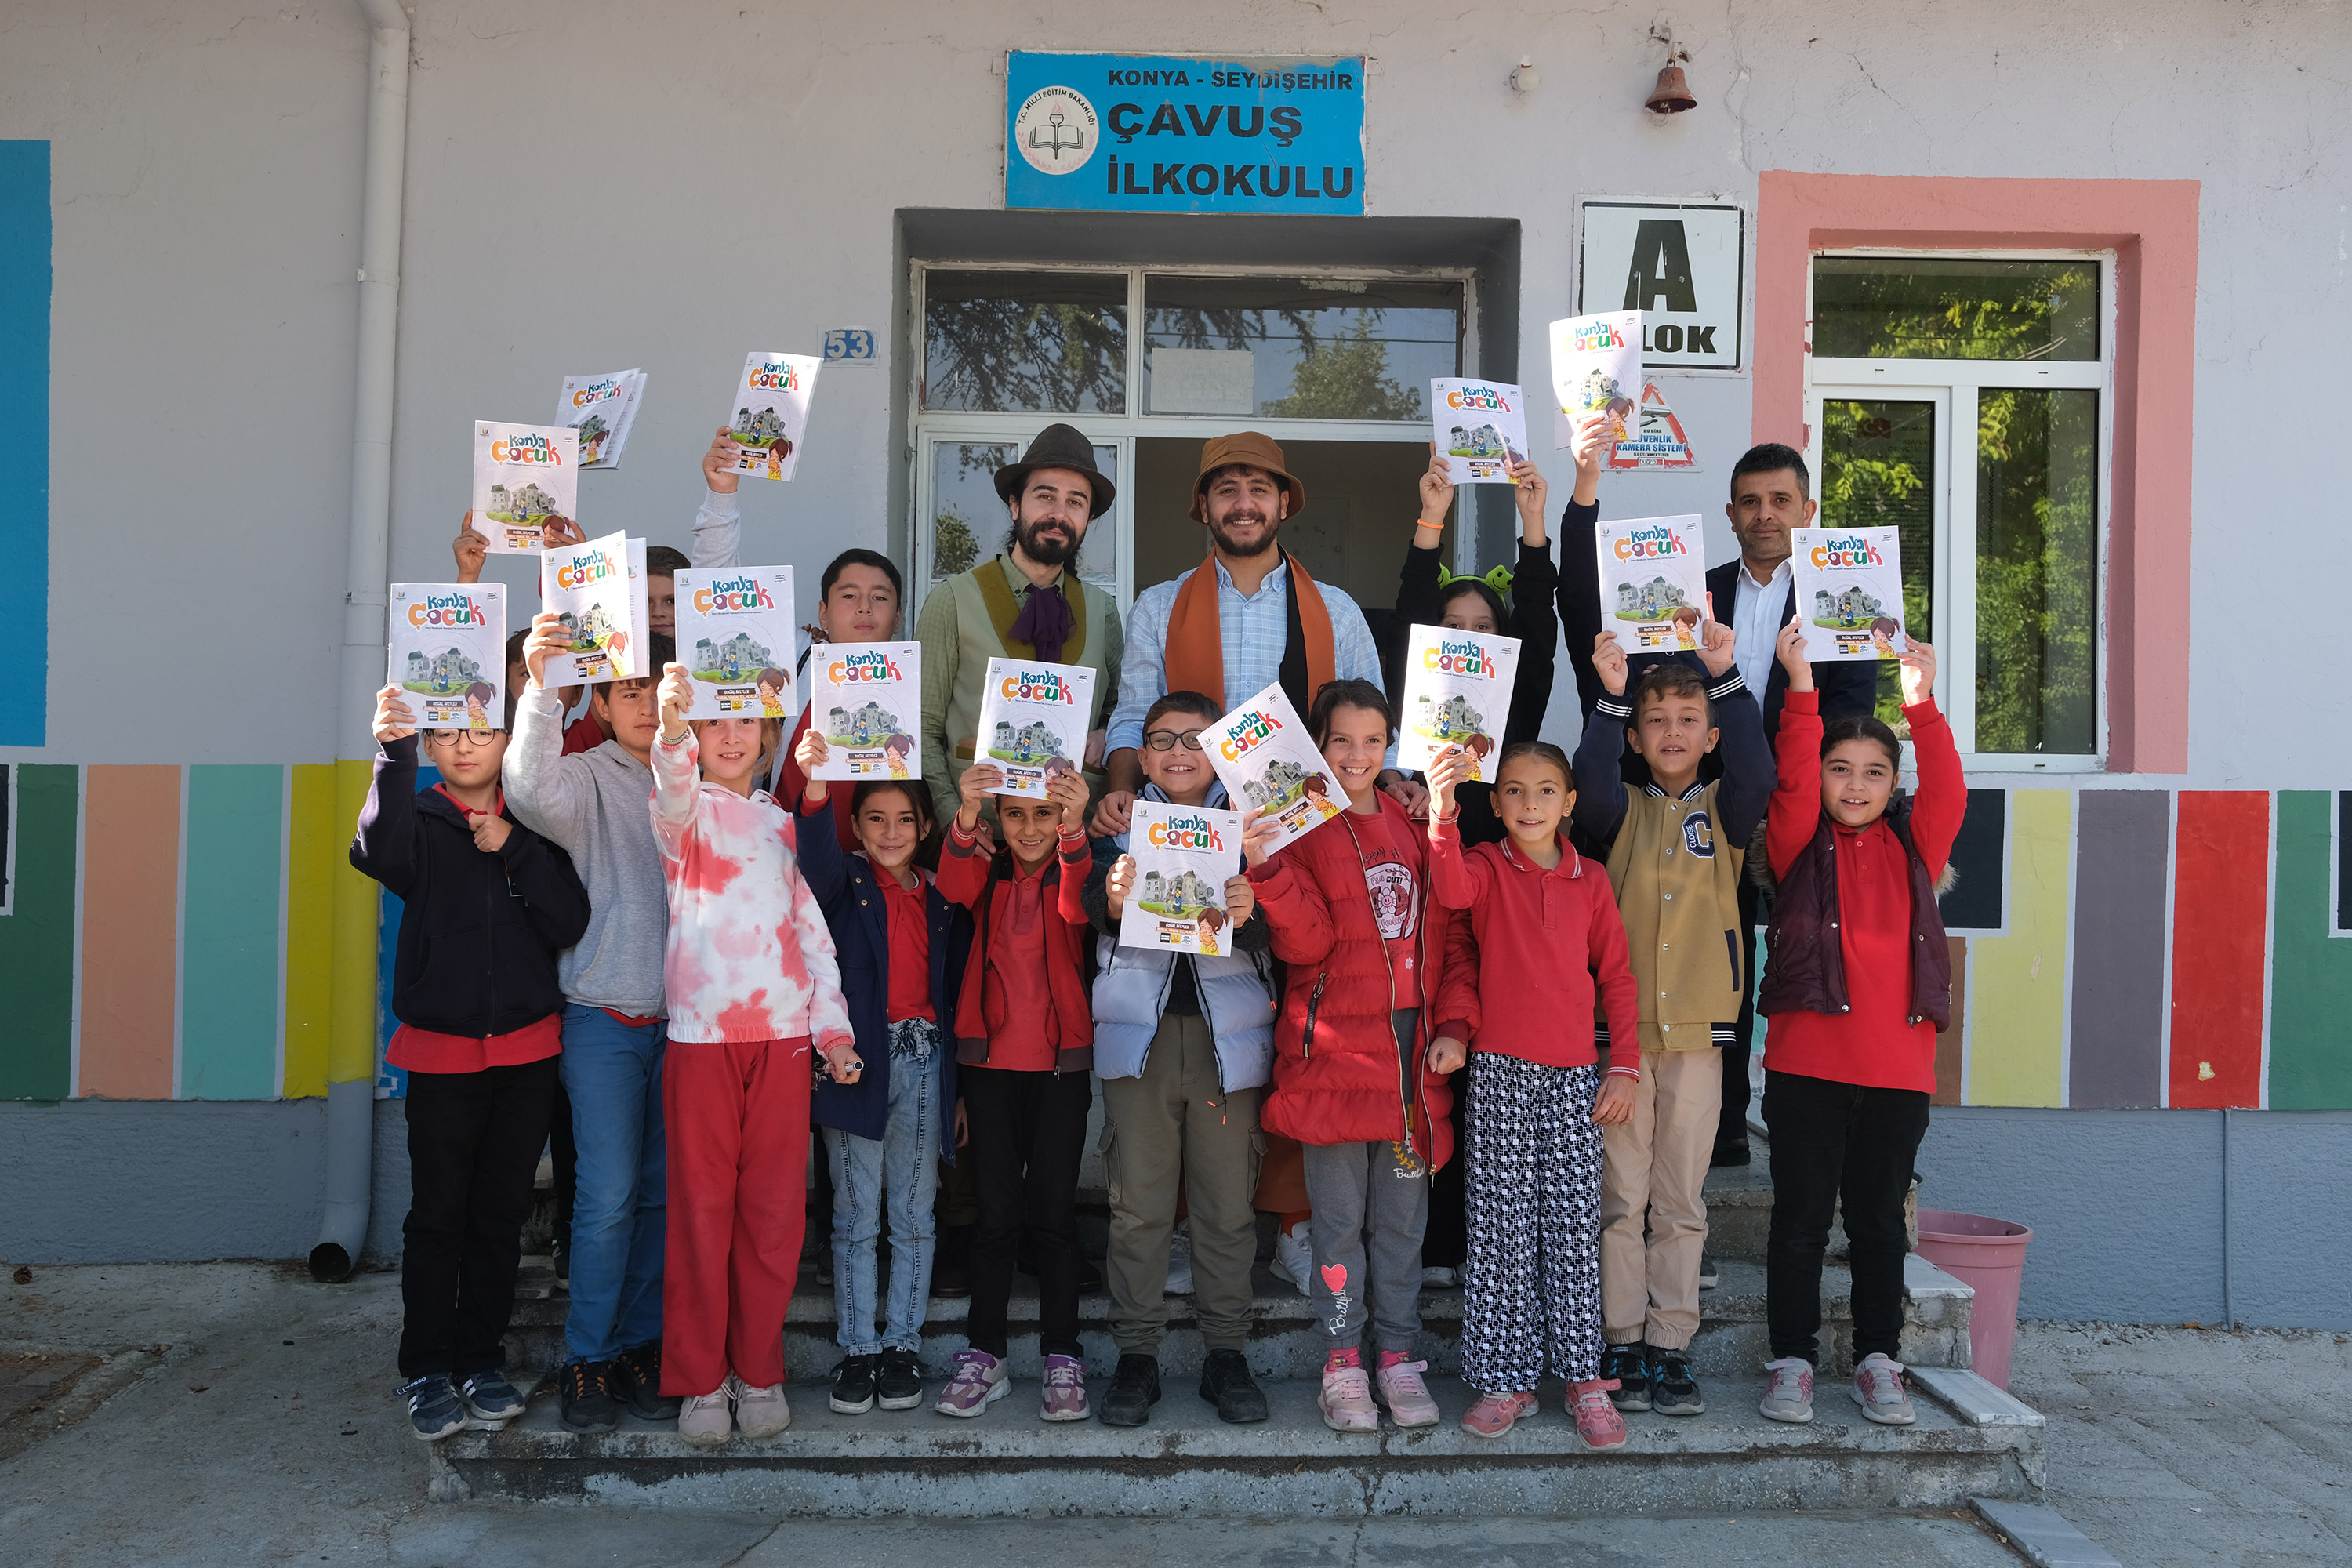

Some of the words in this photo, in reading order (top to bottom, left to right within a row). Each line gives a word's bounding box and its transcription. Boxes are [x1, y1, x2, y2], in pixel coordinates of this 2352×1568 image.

[1109, 70, 1189, 87] KONYA
[1211, 70, 1353, 93] SEYDİŞEHİR
[1025, 93, 1042, 111] MİLLİ
[1043, 88, 1067, 98] EĞİTİM
[1068, 92, 1096, 125] BAKANLIĞI
[1107, 103, 1304, 147] ÇAVUŞ
[1107, 154, 1354, 198] İLKOKULU
[1622, 219, 1697, 313] A
[827, 332, 869, 358] 53
[1643, 325, 1718, 354] LOK
[749, 365, 799, 390] Çocuk
[572, 380, 621, 409] Çocuk
[1447, 390, 1512, 412] Çocuk
[492, 438, 563, 466] Çocuk
[1653, 443, 1687, 452] SİSTEMİ
[1614, 528, 1687, 564] Çocuk
[1810, 539, 1884, 572] Çocuk
[557, 551, 616, 593] Çocuk
[408, 597, 486, 630] Çocuk
[693, 579, 775, 618] Çocuk
[829, 654, 902, 688] Çocuk
[1423, 647, 1496, 679] Çocuk
[1001, 676, 1073, 705] Çocuk
[1220, 710, 1283, 764] Çocuk
[1149, 821, 1224, 851] Çocuk
[1686, 825, 1696, 848] CLOISE
[1364, 846, 1385, 865] ppy
